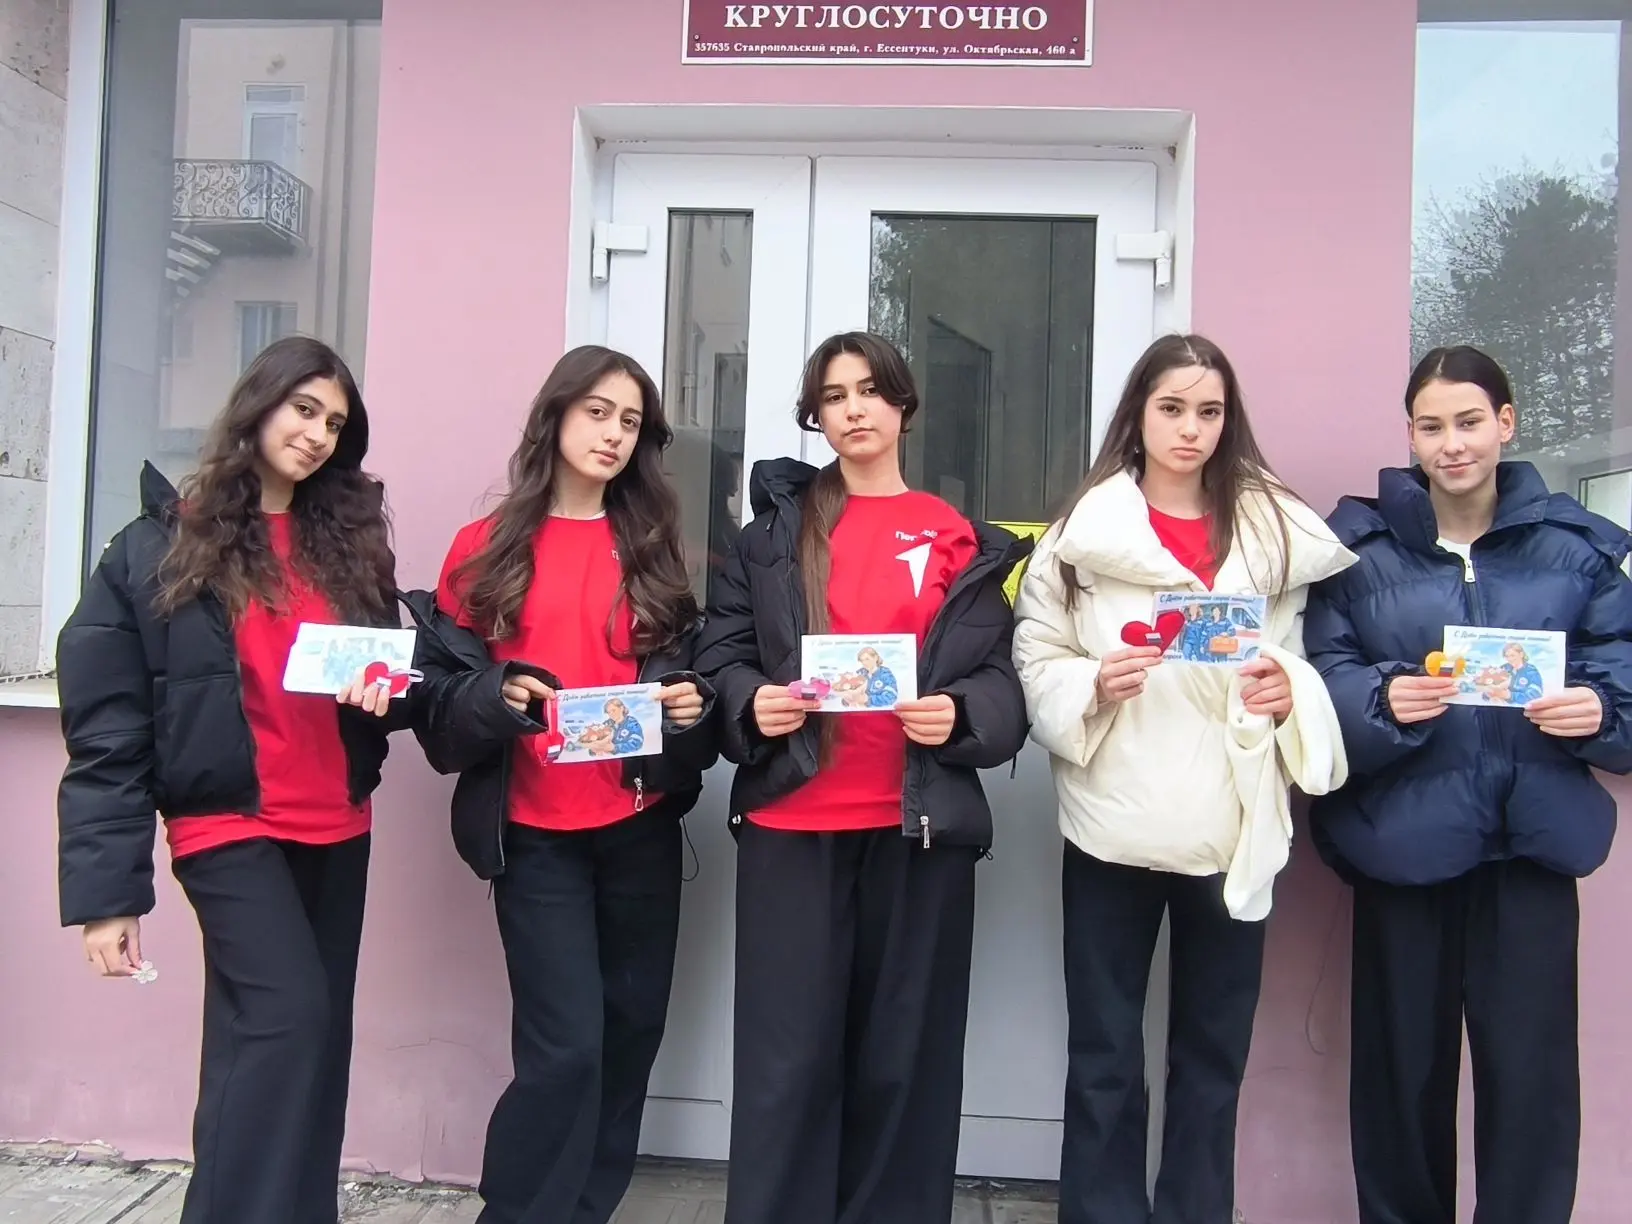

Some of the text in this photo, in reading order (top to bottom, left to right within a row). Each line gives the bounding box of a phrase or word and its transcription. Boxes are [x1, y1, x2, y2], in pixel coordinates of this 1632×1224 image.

[724, 5, 1048, 31] КРУГЛОСУТОЧНО
[694, 42, 730, 52] 357635
[734, 43, 826, 54] Ставропольский
[829, 43, 860, 55] край,
[864, 45, 873, 53] г.
[876, 43, 939, 55] Ессентуки,
[943, 46, 960, 55] ул.
[963, 44, 1042, 56] Октябрьская,
